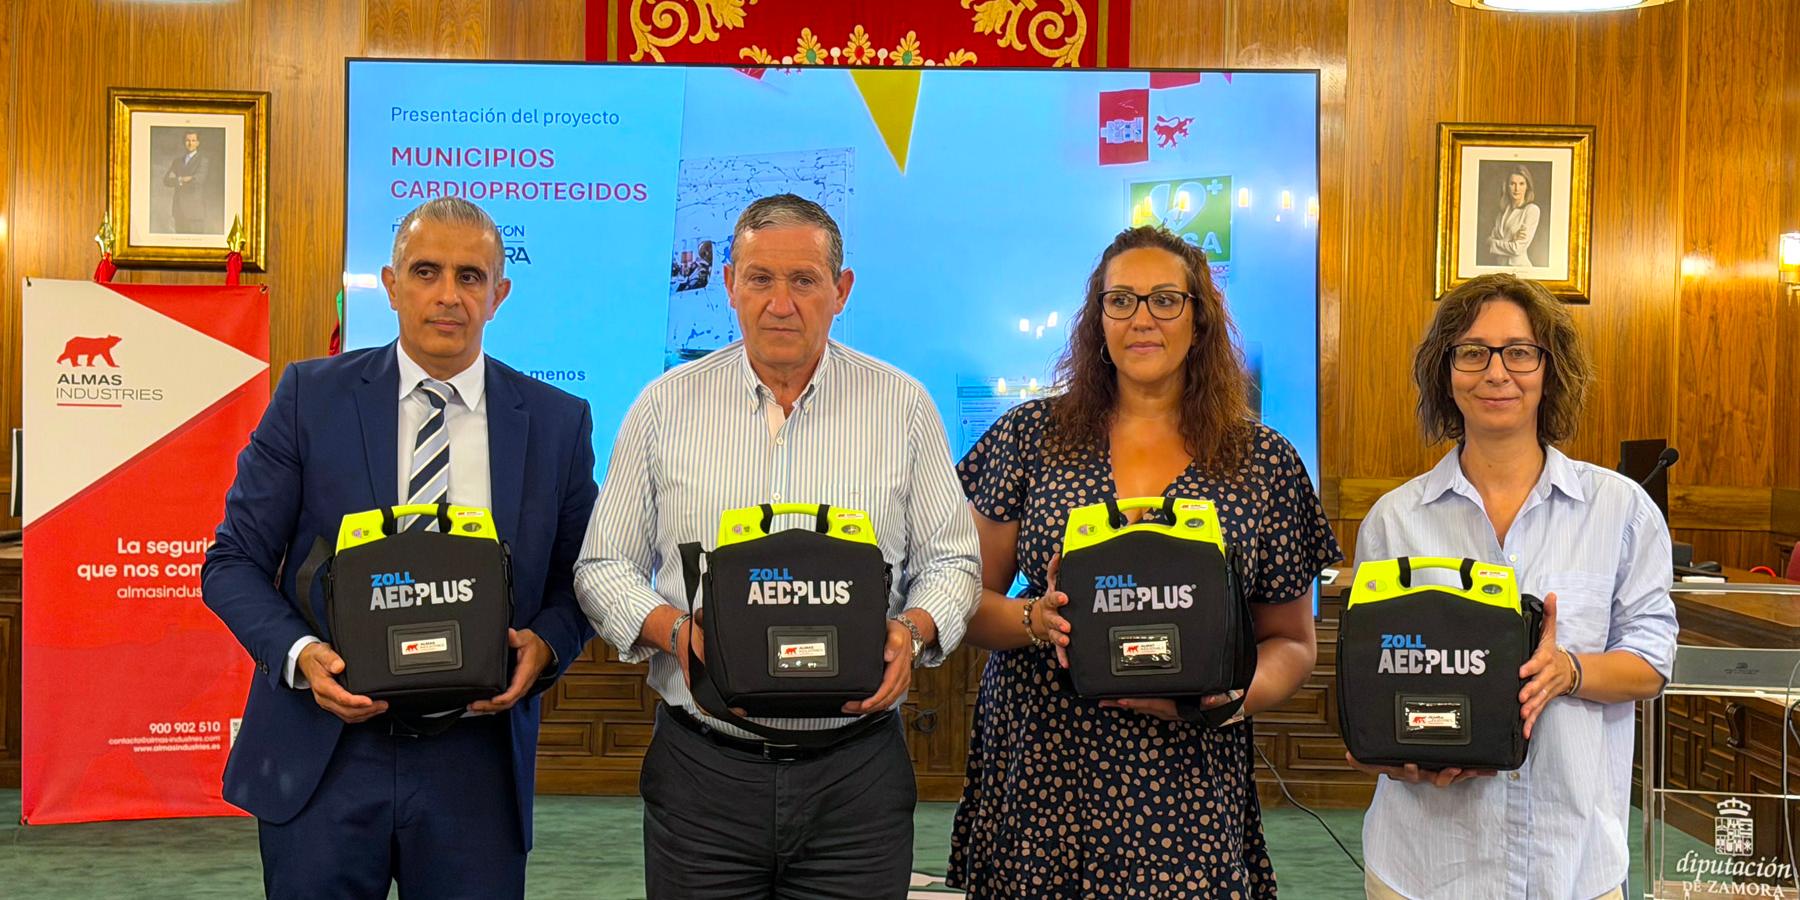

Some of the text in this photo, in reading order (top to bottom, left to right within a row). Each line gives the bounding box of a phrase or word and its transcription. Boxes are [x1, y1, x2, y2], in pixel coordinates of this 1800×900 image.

[391, 106, 620, 128] Presentación del proyecto
[391, 146, 555, 168] MUNICIPIOS
[391, 180, 648, 201] CARDIOPROTEGIDOS
[57, 373, 122, 386] ALMAS
[529, 370, 586, 381] menos
[56, 387, 163, 401] INDUSTRIES
[117, 537, 216, 558] La seguri
[77, 564, 117, 581] que
[123, 564, 159, 577] nos
[370, 571, 415, 588] ZOLL
[749, 567, 794, 581] ZOLL
[1094, 574, 1137, 589] ZOLL
[1381, 634, 1427, 649] ZOLL
[149, 721, 220, 734] 900 902 510
[1676, 850, 1792, 880] diputación
[1683, 881, 1785, 898] DE ZAMORA
